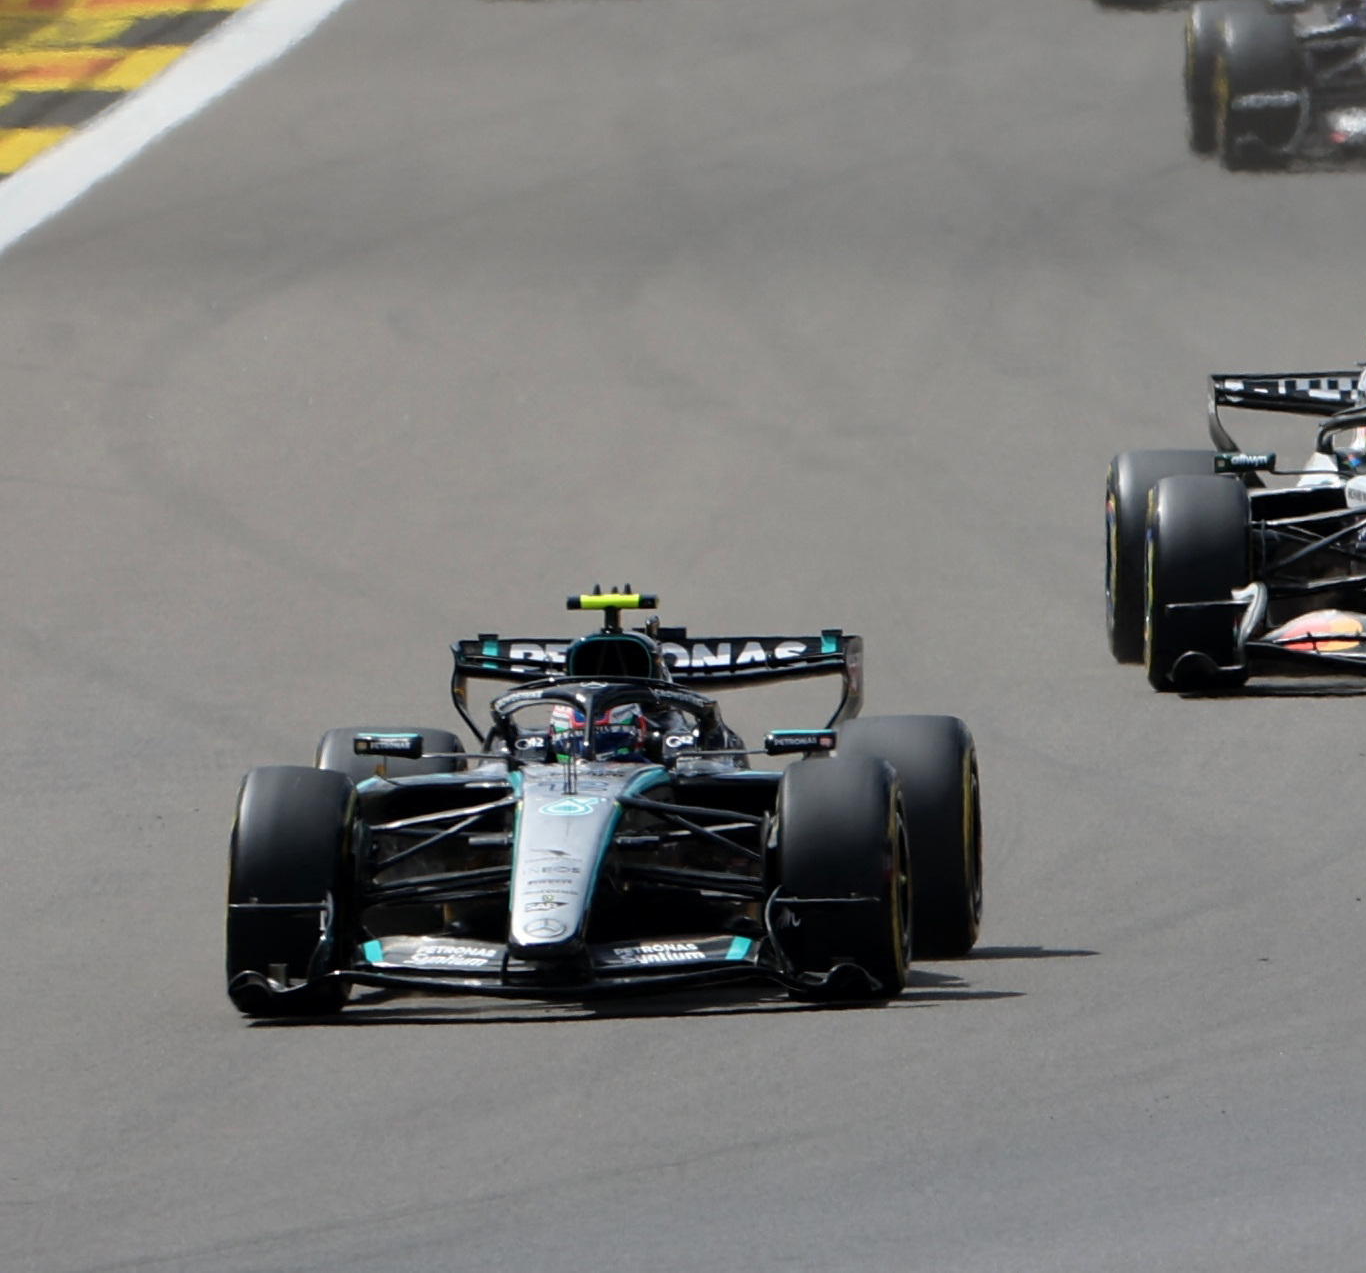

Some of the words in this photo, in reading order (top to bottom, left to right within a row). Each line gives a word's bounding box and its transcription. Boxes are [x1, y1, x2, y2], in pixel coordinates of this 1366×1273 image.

[508, 640, 808, 673] PEONAS
[416, 945, 496, 958] PETRONAS
[613, 942, 698, 956] PETRONAS
